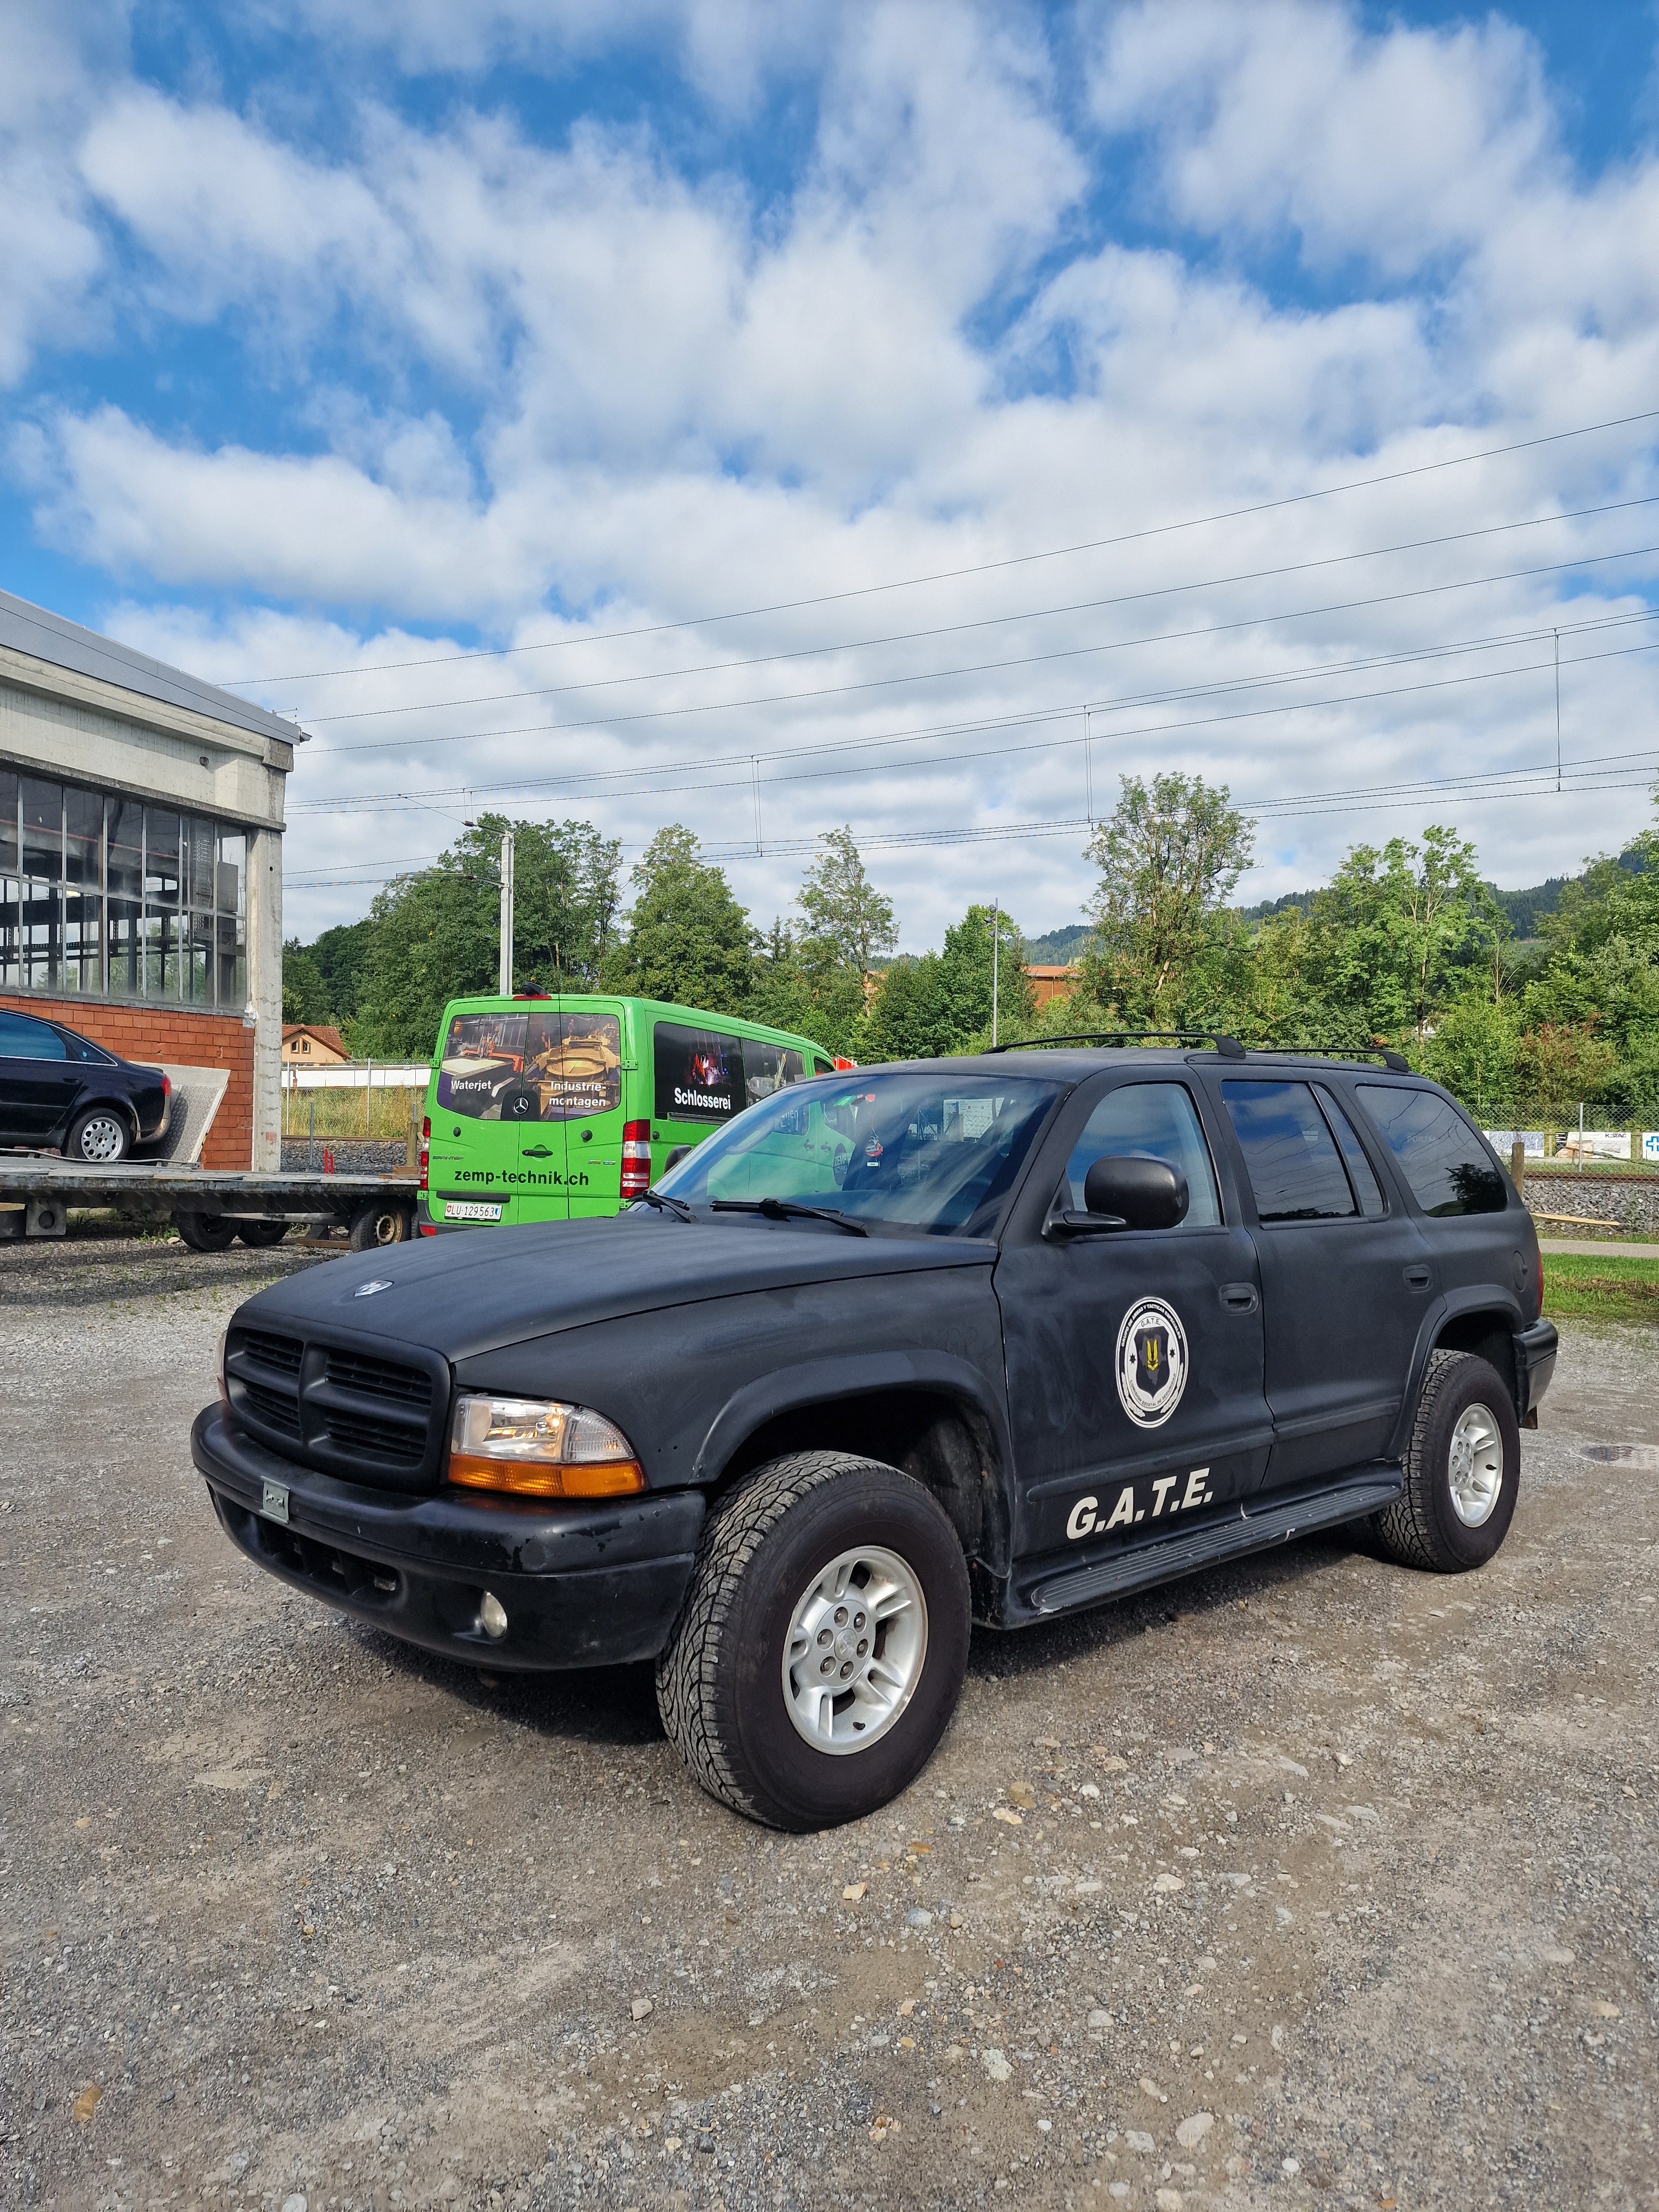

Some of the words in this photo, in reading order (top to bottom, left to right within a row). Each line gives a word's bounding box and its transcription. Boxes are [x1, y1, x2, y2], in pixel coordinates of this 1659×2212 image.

[451, 1080, 492, 1091] Waterjet
[551, 1081, 606, 1091] Industrie-
[549, 1096, 606, 1107] montagen
[674, 1087, 731, 1110] Schlosserei
[455, 1170, 589, 1186] zemp-technik.ch
[1121, 1326, 1129, 1347] GRUPO
[1128, 1318, 1133, 1327] DE
[1132, 1306, 1144, 1320] ARMAS
[1164, 1311, 1181, 1339] ESPECIALES
[1141, 1318, 1161, 1327] G.A.T.E.
[1162, 1373, 1176, 1400] SEGURIDAD
[1066, 1467, 1213, 1540] G.A.T.E.
